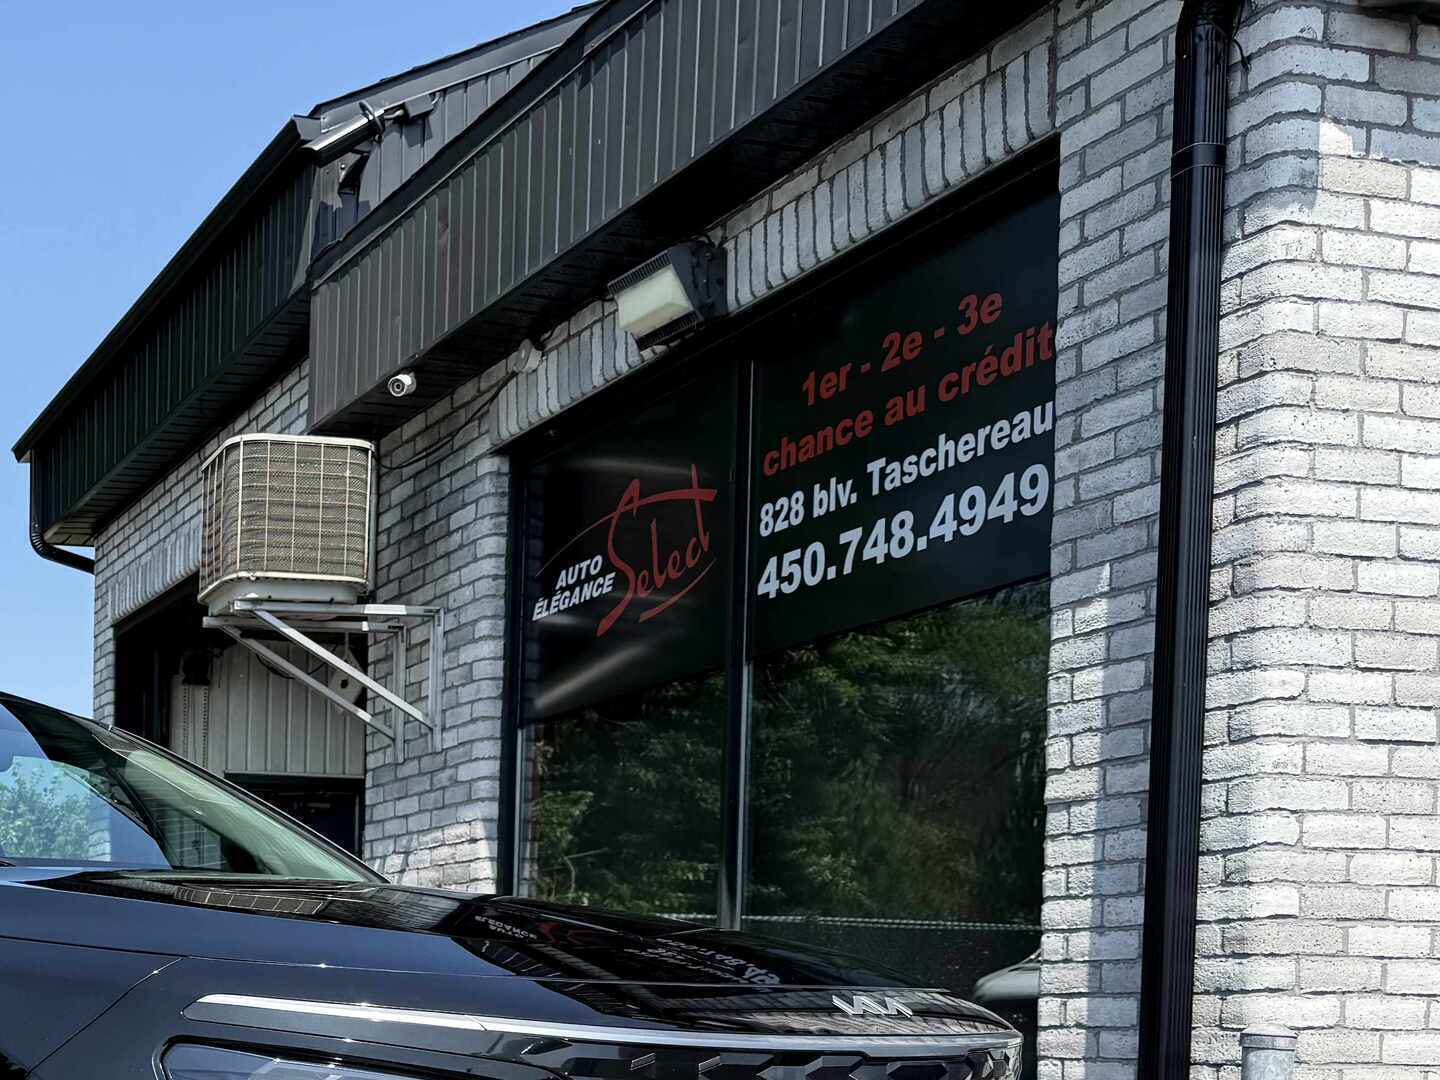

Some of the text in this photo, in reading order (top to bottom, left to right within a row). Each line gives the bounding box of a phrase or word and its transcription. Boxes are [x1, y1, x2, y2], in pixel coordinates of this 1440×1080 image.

[763, 321, 1054, 476] chance au crédit
[802, 370, 852, 406] 1er
[881, 331, 924, 373] 2e
[957, 293, 1003, 336] 3e
[757, 463, 1050, 599] 450.748.4949
[760, 401, 1054, 537] 828 blv. Taschereau
[532, 572, 616, 621] ÉLÉGANCE
[556, 555, 603, 590] AUTO
[596, 463, 718, 637] Select
